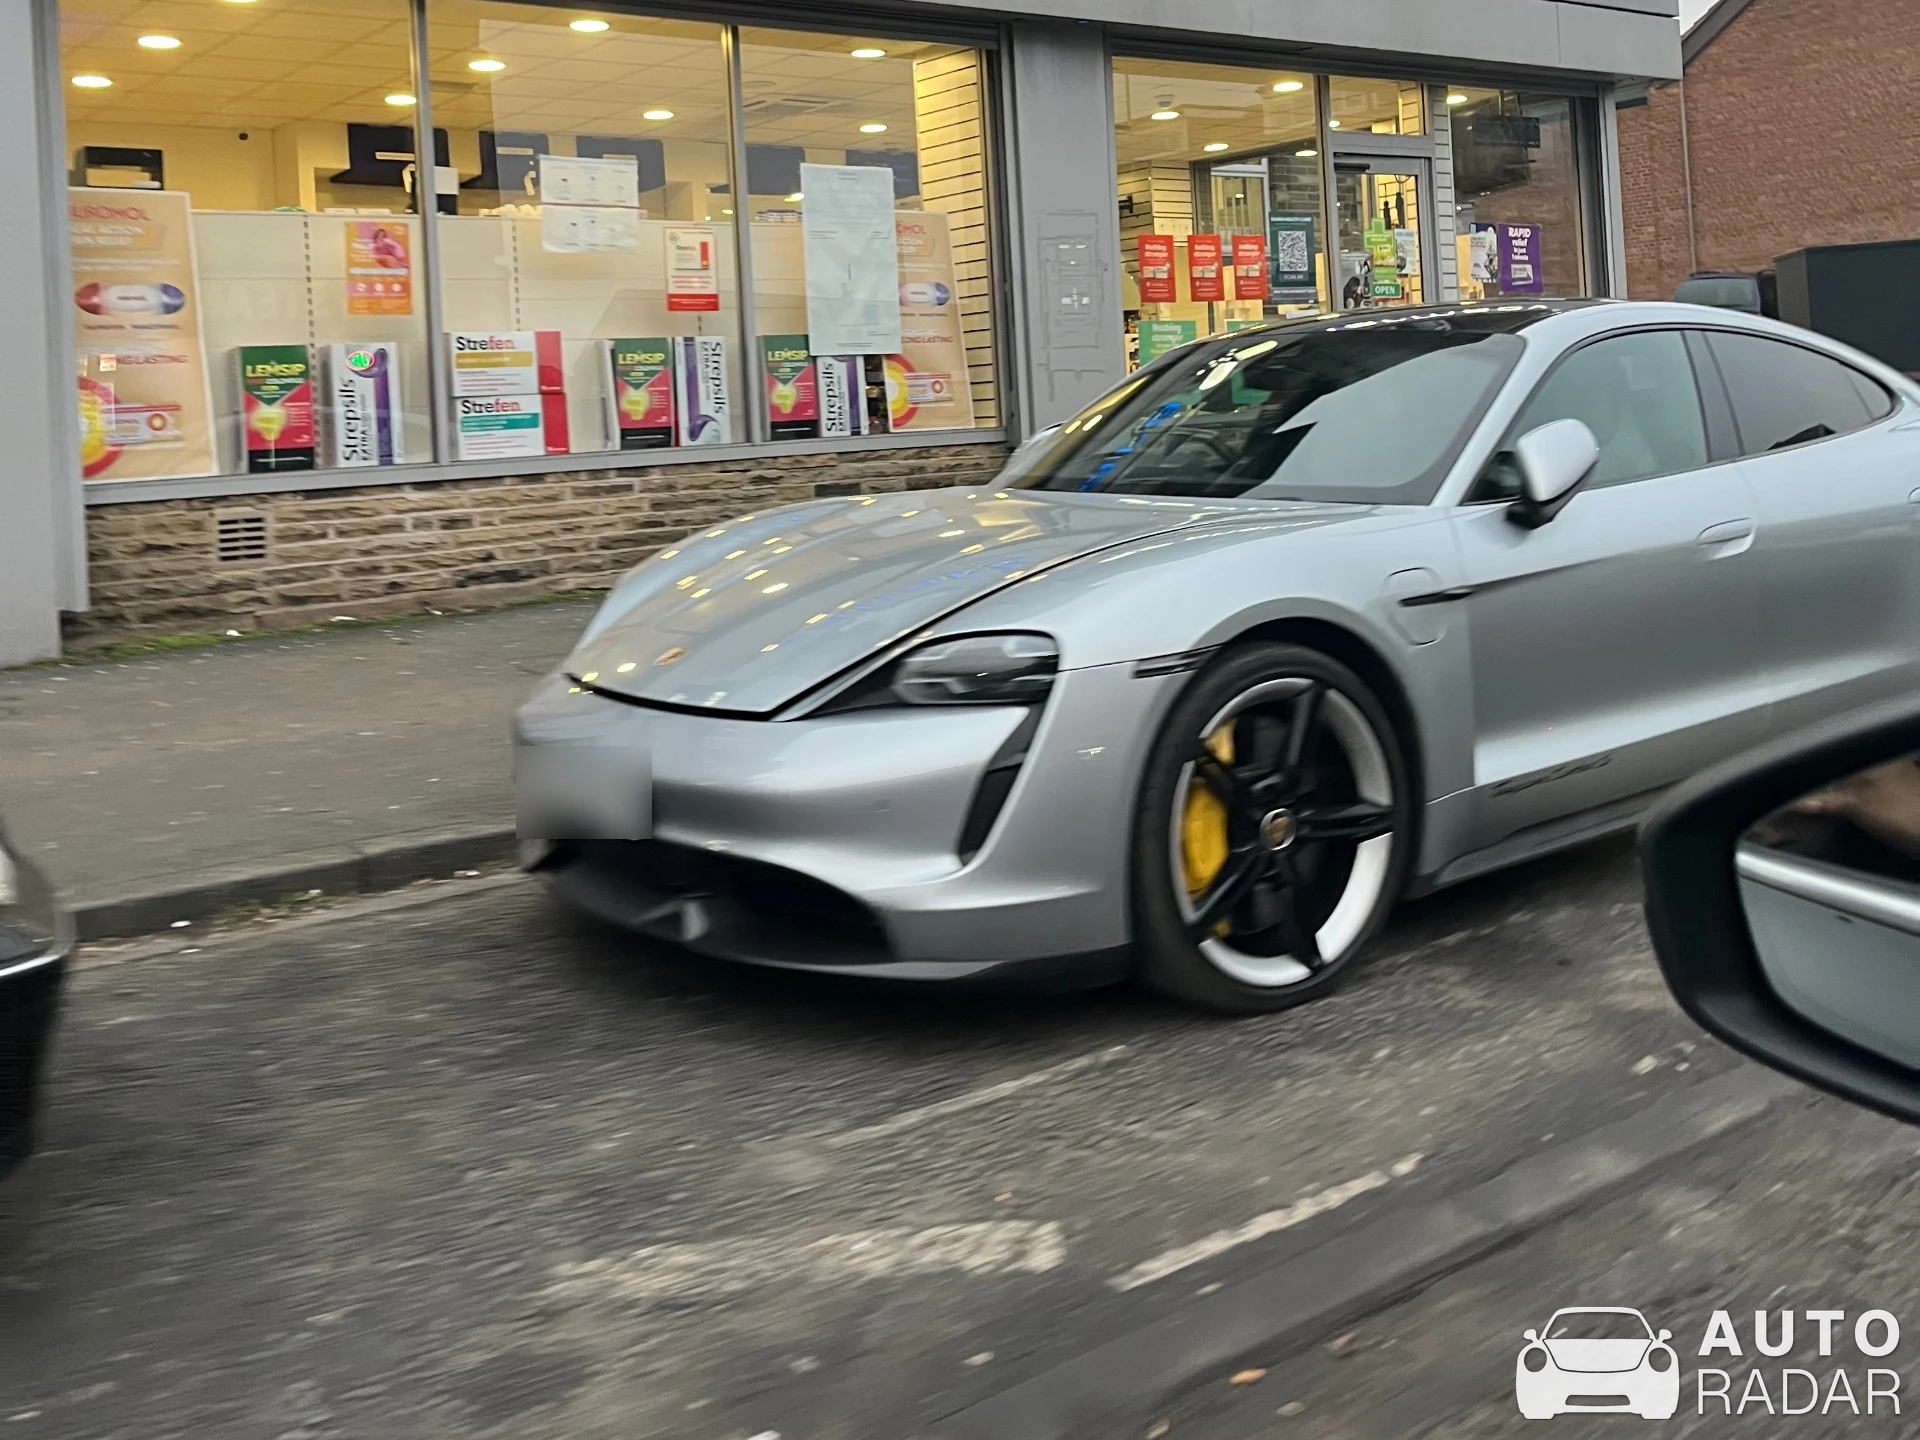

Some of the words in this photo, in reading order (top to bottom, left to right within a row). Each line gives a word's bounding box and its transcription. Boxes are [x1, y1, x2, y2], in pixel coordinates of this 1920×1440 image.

[68, 204, 152, 221] UROMOL
[1508, 227, 1532, 238] RAPID
[1374, 285, 1396, 295] OPEN
[456, 336, 516, 351] Strefen
[618, 352, 666, 365] LEMSIP
[767, 350, 809, 361] LEMSIP
[246, 363, 306, 377] LEMSIP
[710, 342, 727, 414] Strepsils
[822, 363, 838, 432] Strepsils
[461, 398, 521, 414] Strefen
[340, 378, 361, 461] Strepsils
